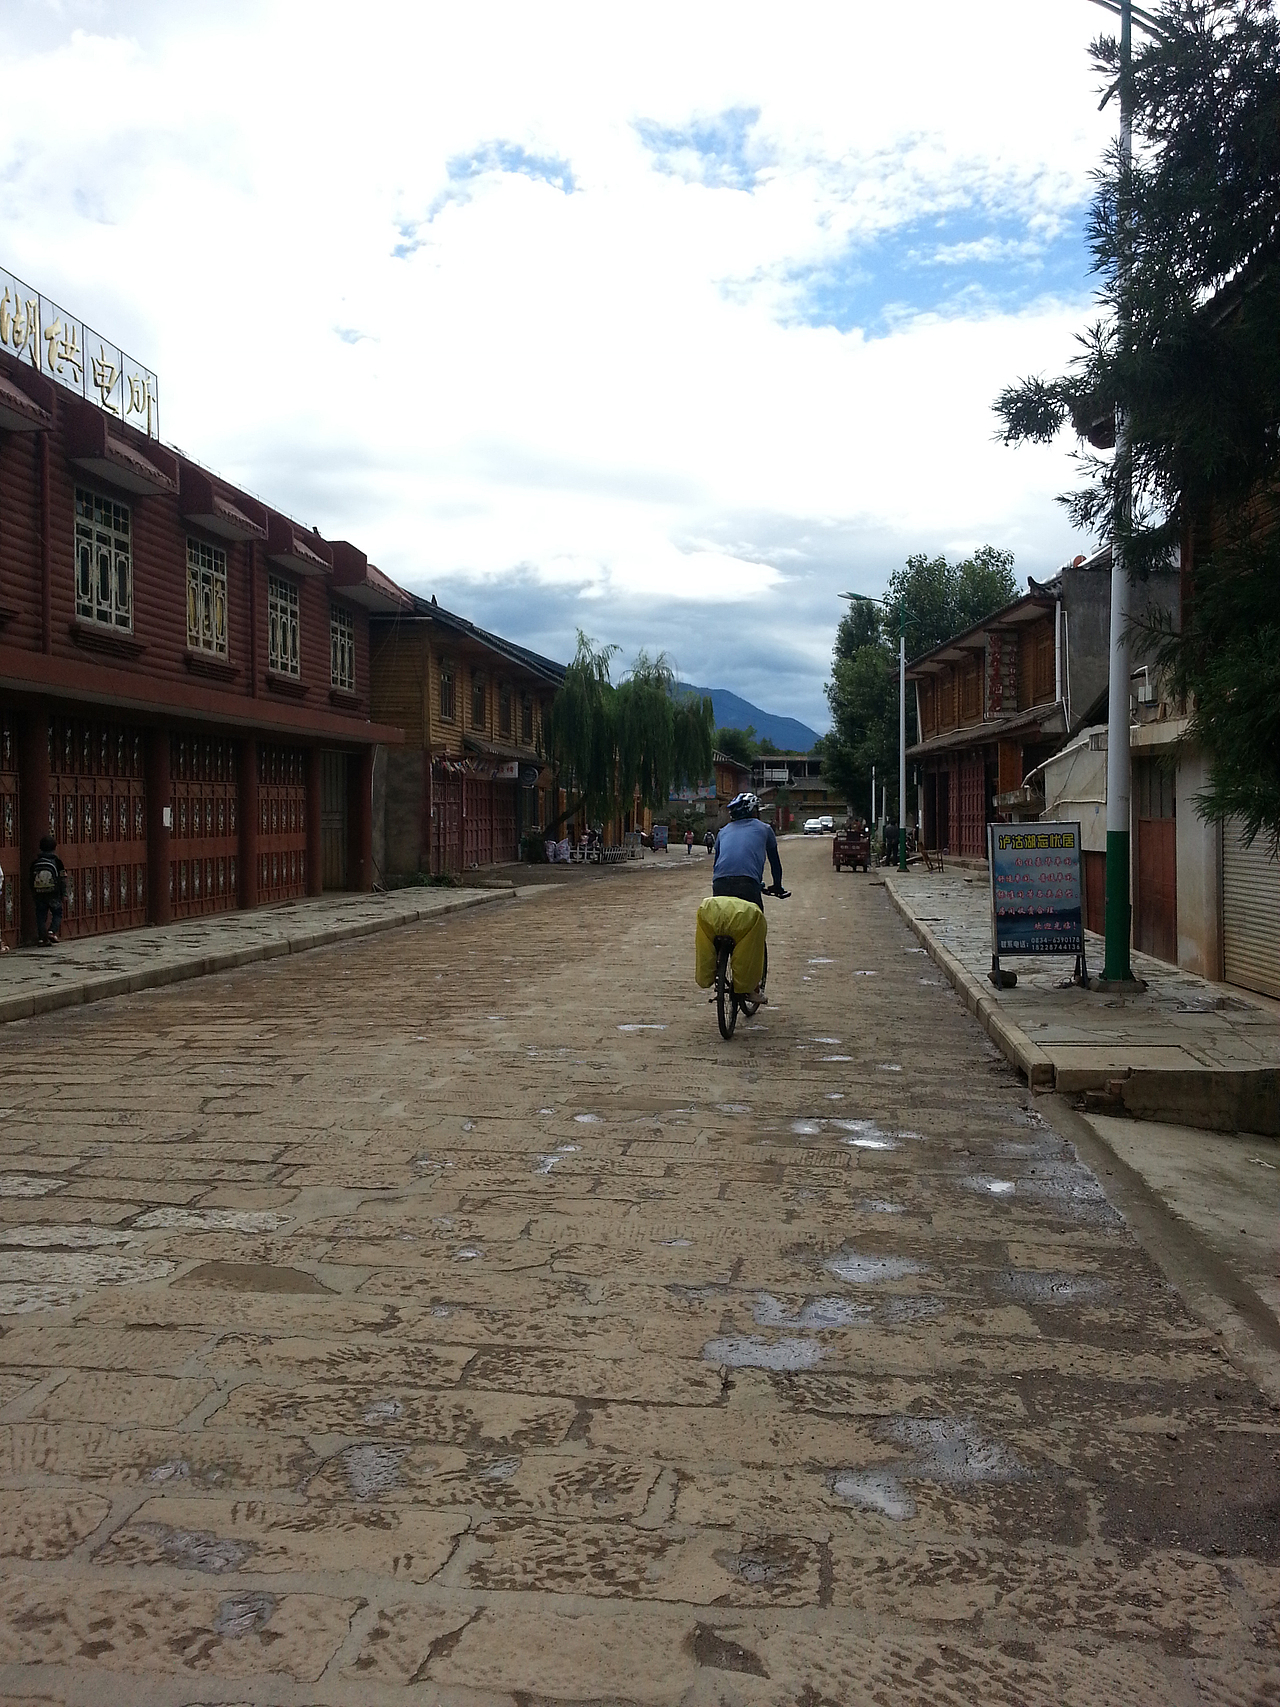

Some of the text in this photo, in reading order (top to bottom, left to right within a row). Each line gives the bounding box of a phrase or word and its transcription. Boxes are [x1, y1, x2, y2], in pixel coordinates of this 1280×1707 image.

[0, 286, 156, 438] 湖供电所
[999, 832, 1075, 849] 泸沽湖忘忧居
